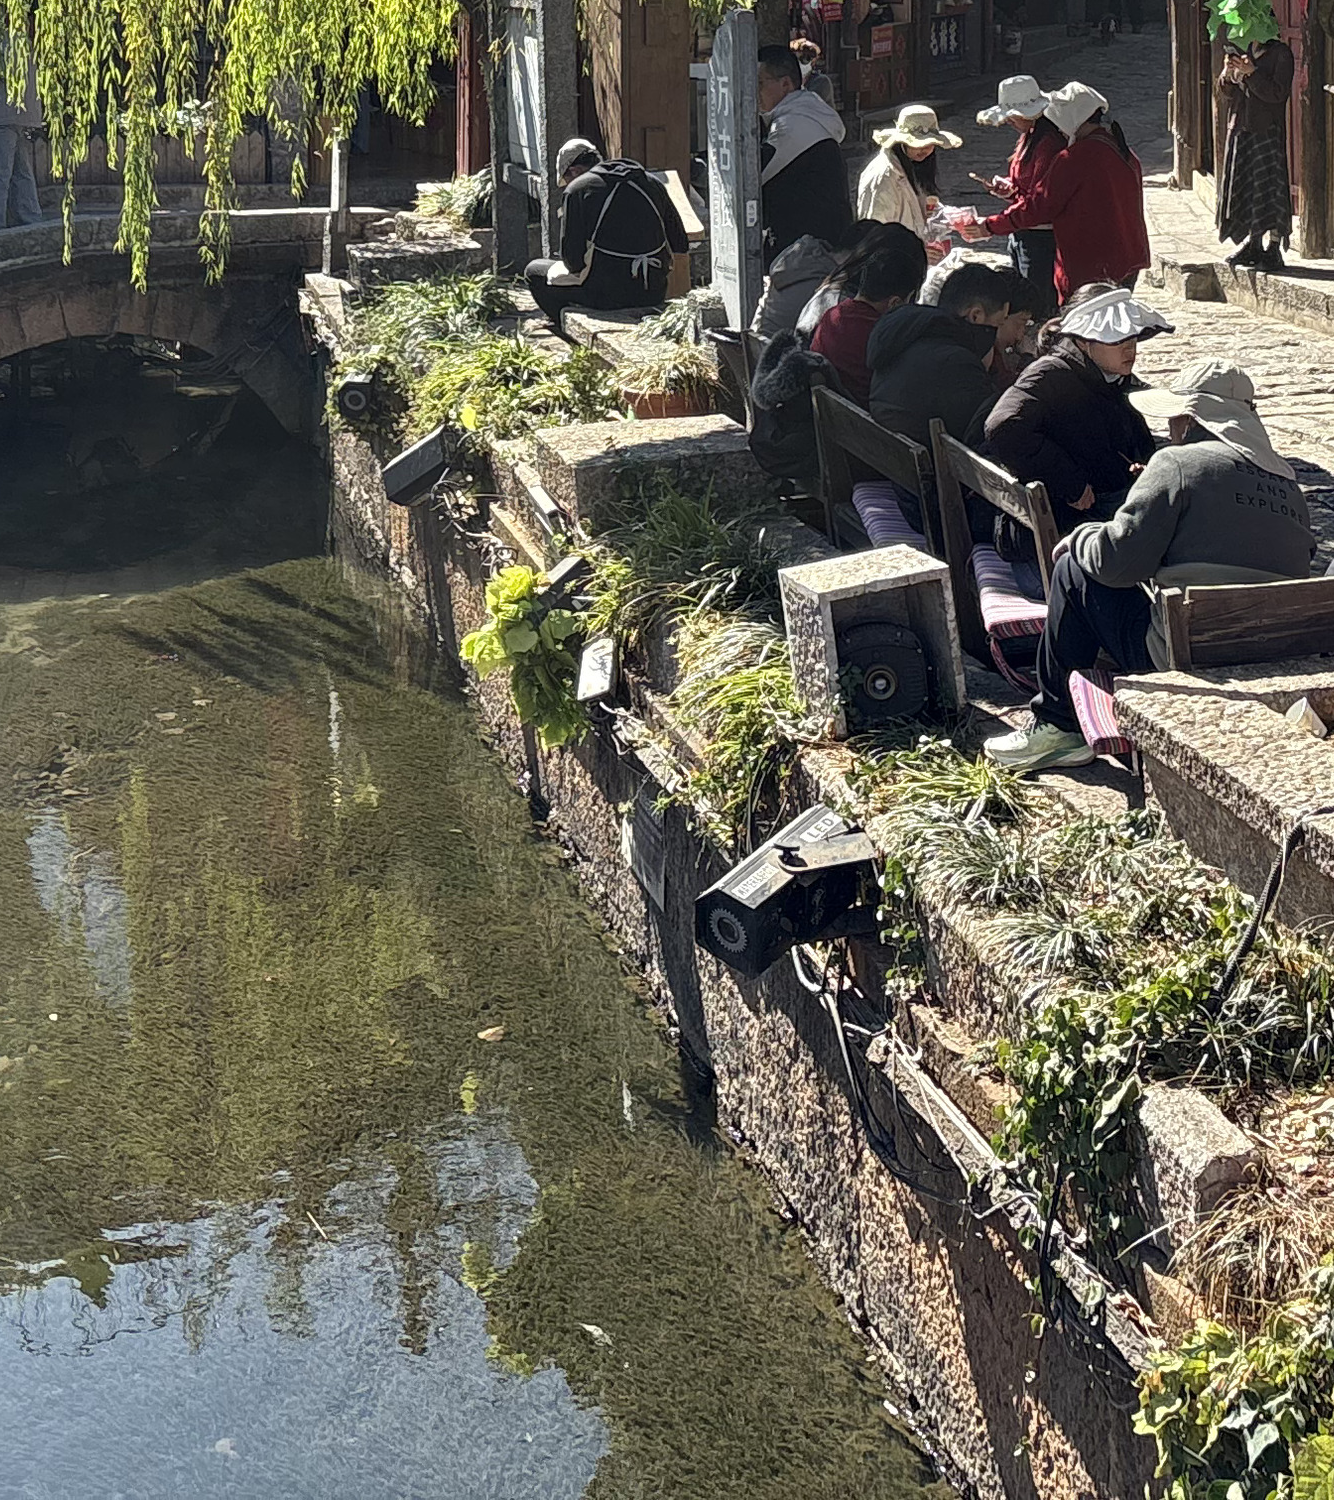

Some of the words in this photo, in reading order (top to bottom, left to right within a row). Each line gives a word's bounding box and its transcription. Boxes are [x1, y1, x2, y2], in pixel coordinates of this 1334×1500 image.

[1256, 482, 1287, 500] AND
[1235, 492, 1305, 526] EXPLORE
[806, 817, 835, 838] LED
